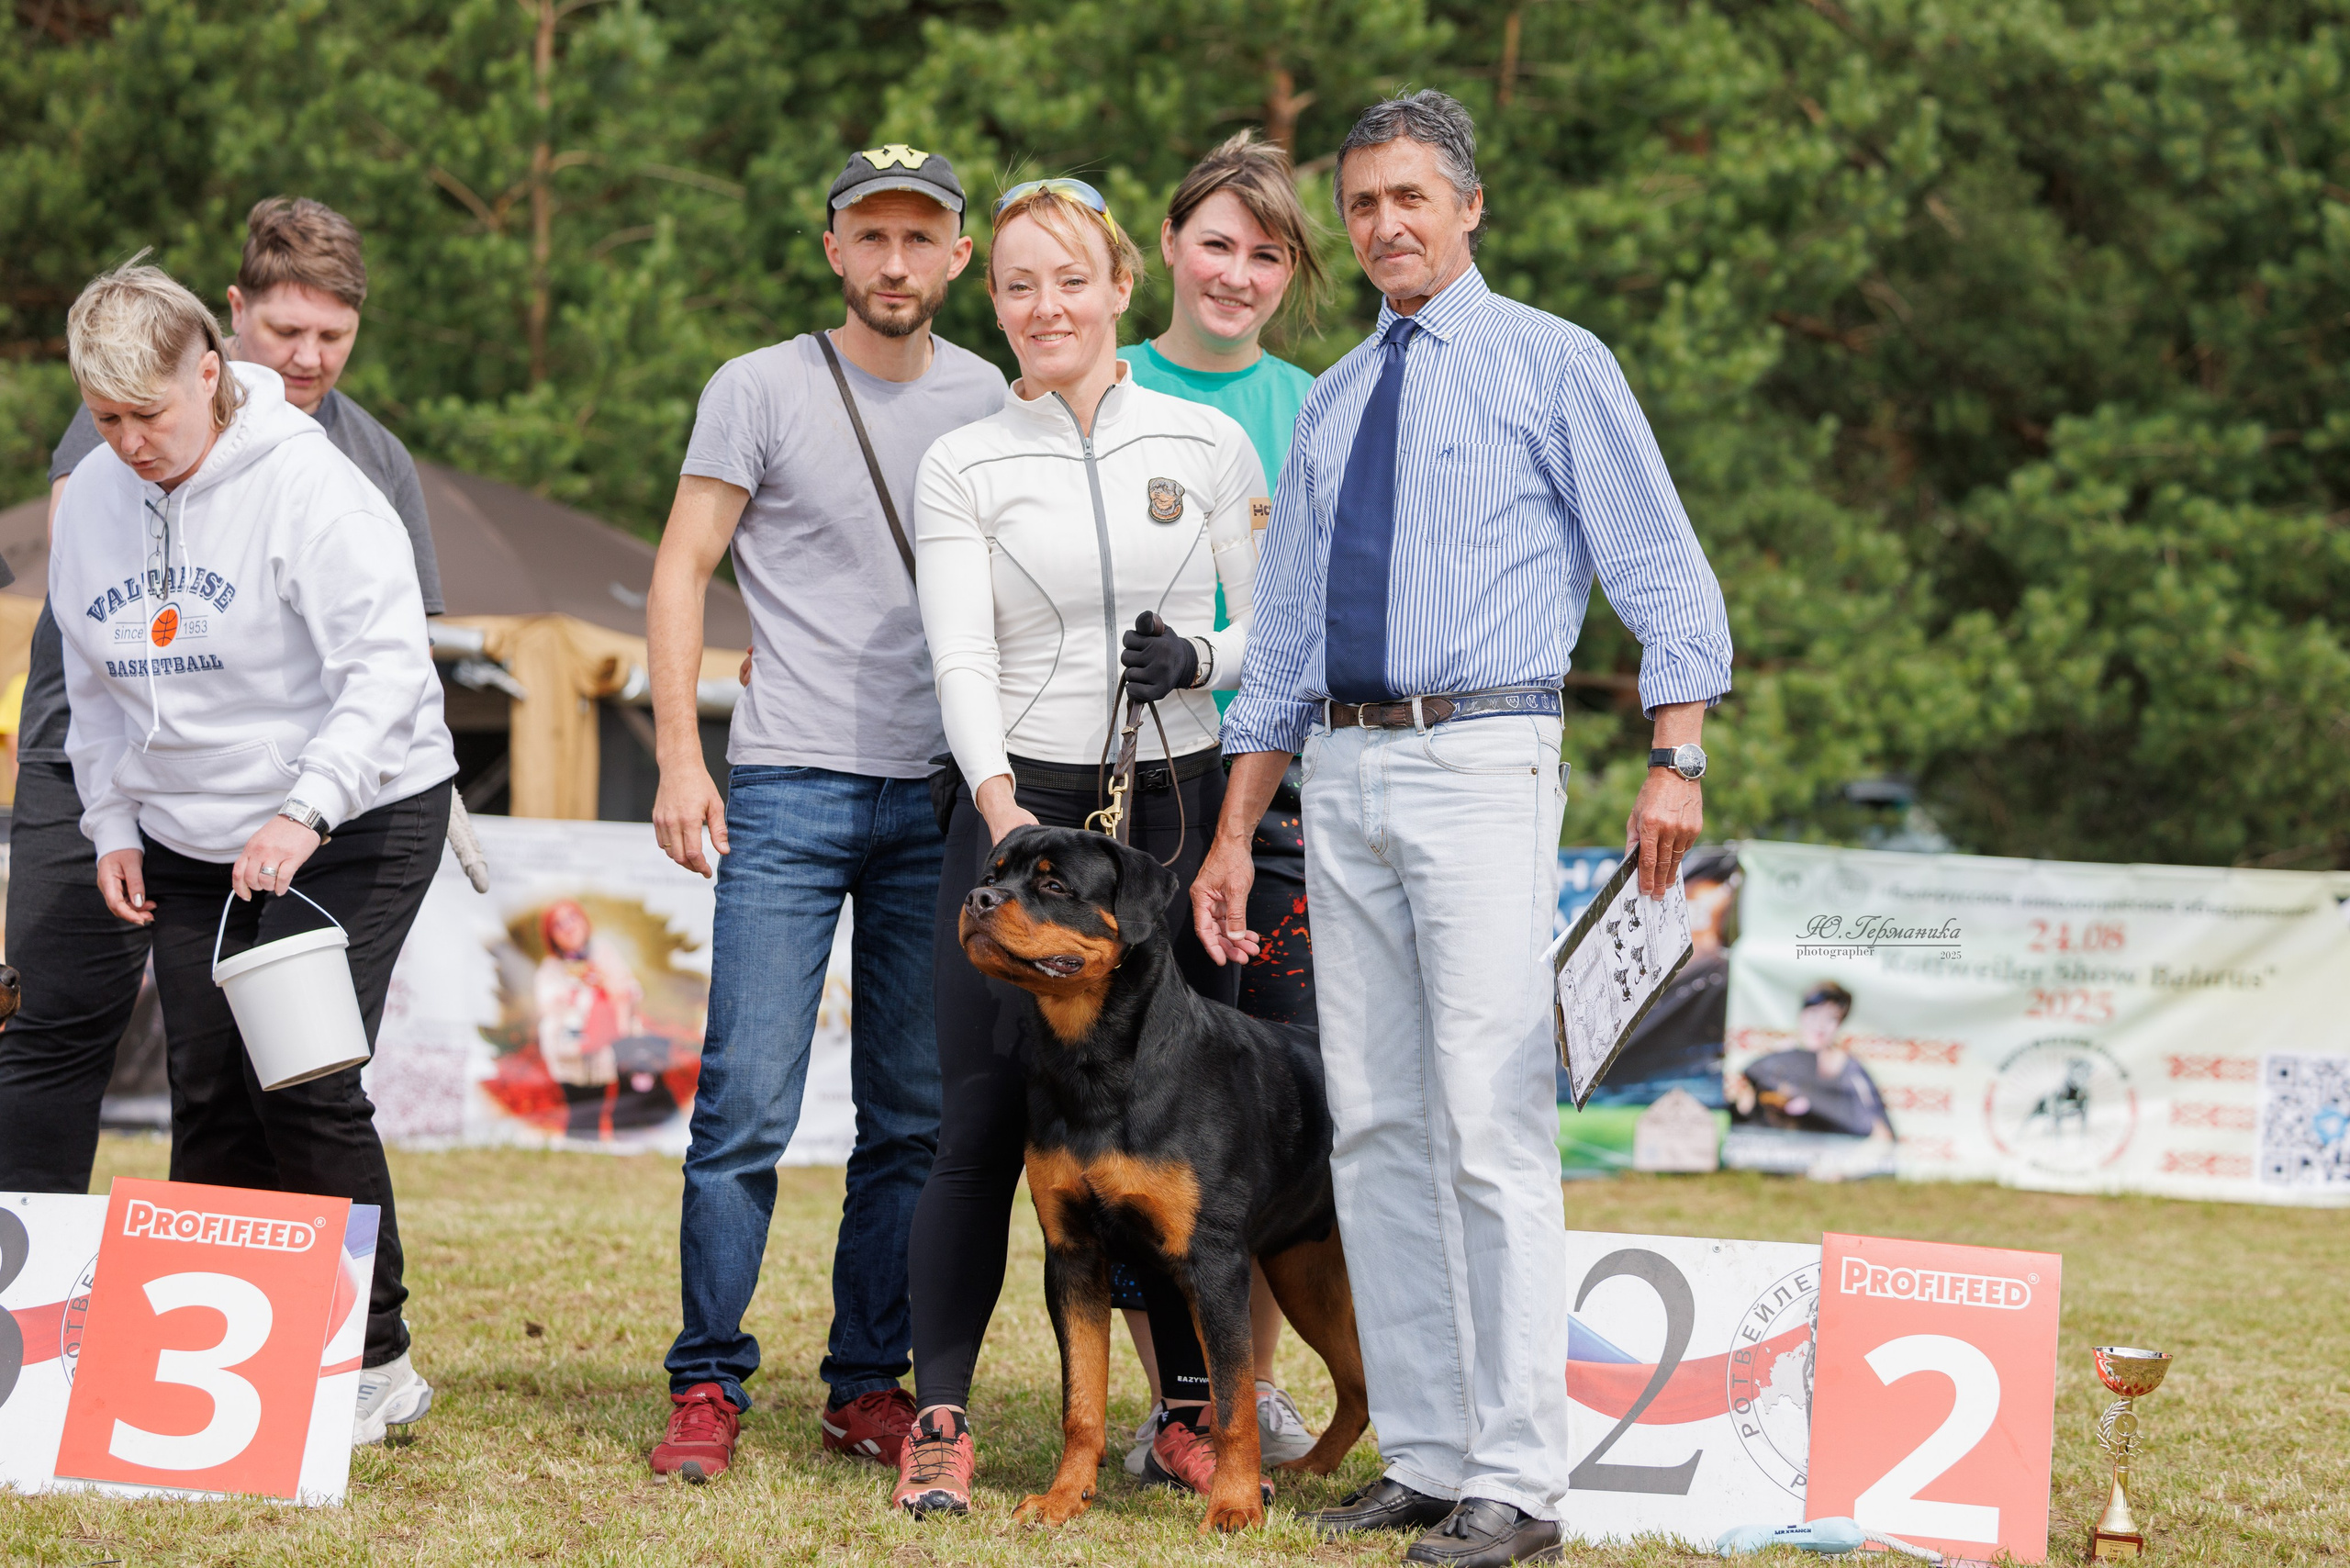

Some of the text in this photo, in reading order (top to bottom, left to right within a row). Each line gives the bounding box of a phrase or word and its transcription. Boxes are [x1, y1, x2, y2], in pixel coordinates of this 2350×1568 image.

[106, 655, 225, 678] BASKETBALL
[114, 621, 207, 641] since 1953
[109, 1271, 274, 1471] 3
[1567, 1248, 1704, 1496] 2
[1731, 1267, 1820, 1439] РОТВЕЙЛЕ
[1854, 1334, 2001, 1544] 2
